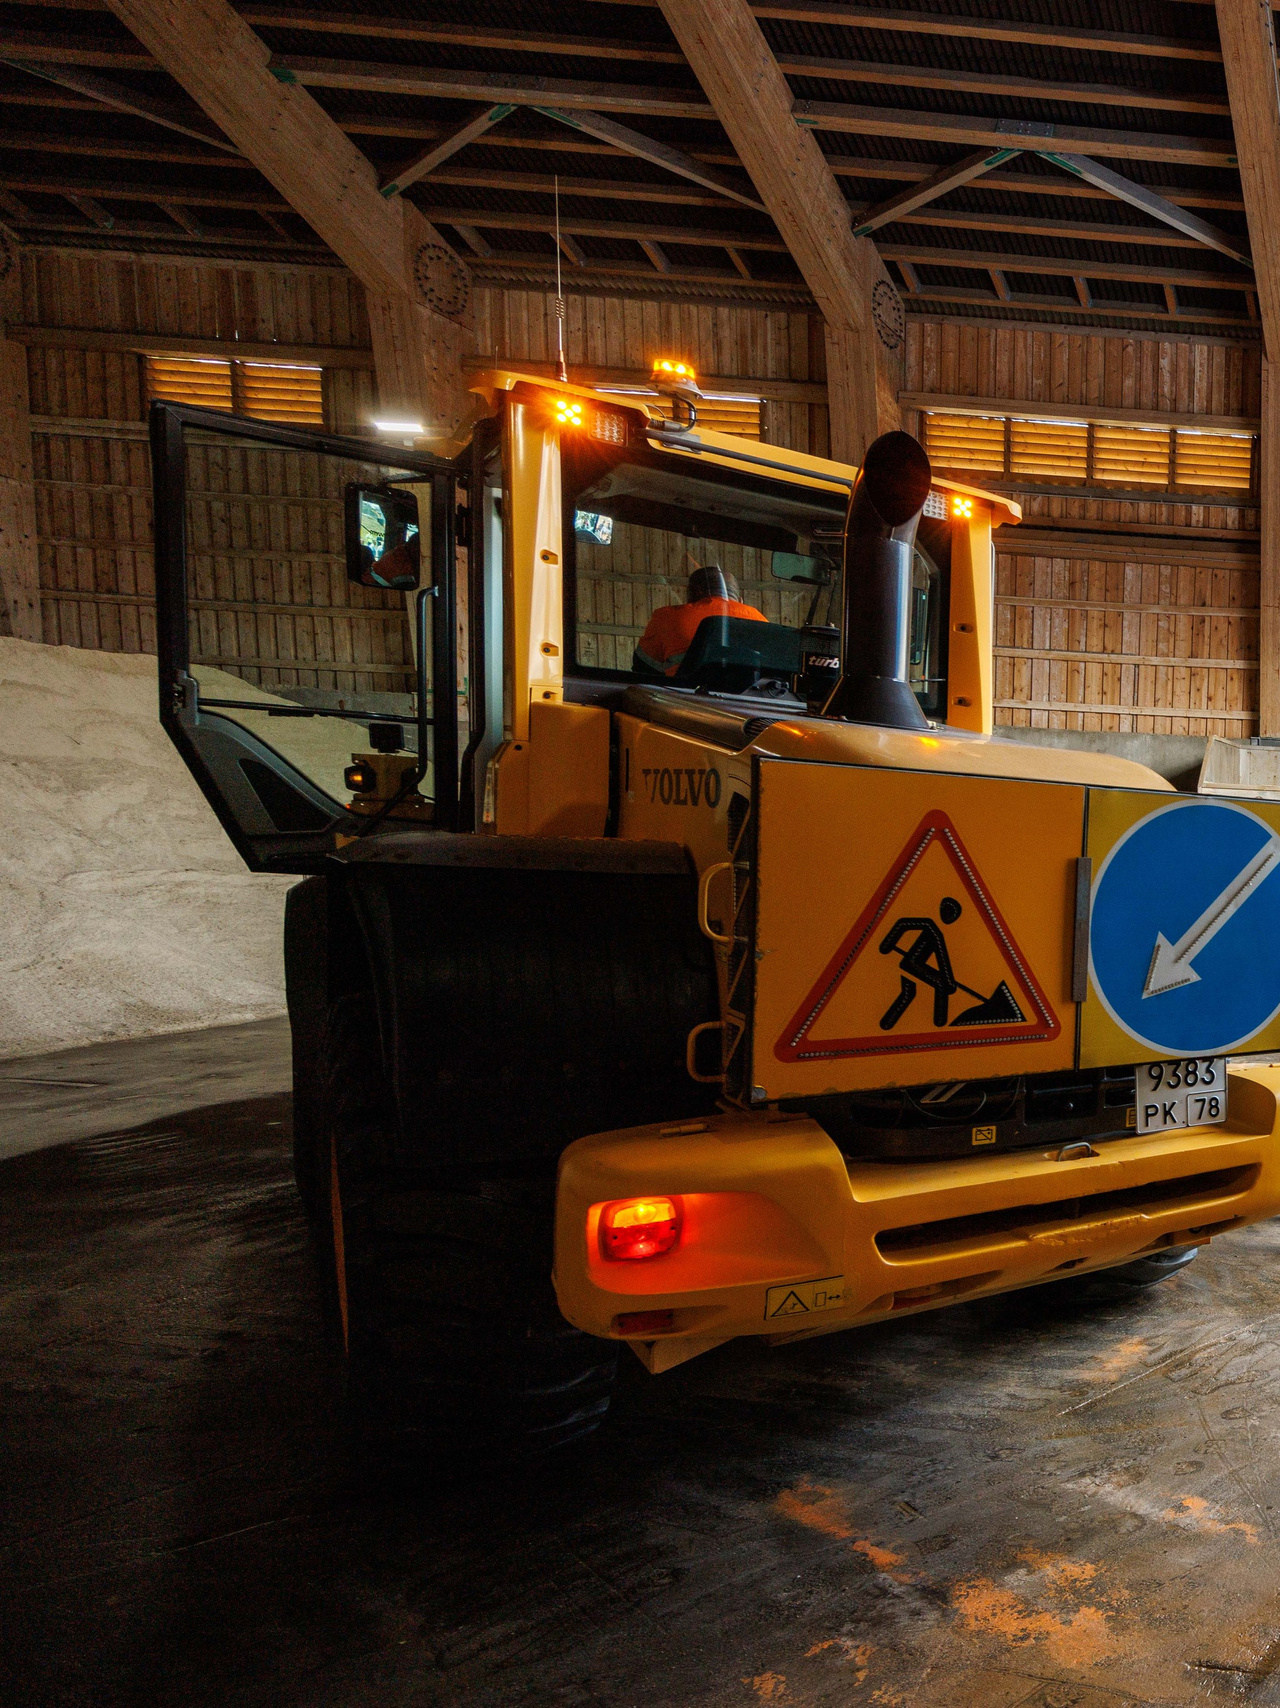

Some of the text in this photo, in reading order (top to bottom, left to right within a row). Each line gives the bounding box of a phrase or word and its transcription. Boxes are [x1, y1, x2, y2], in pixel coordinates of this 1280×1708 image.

[808, 655, 840, 669] turb
[1148, 1058, 1216, 1092] 9383
[1195, 1096, 1220, 1120] 78
